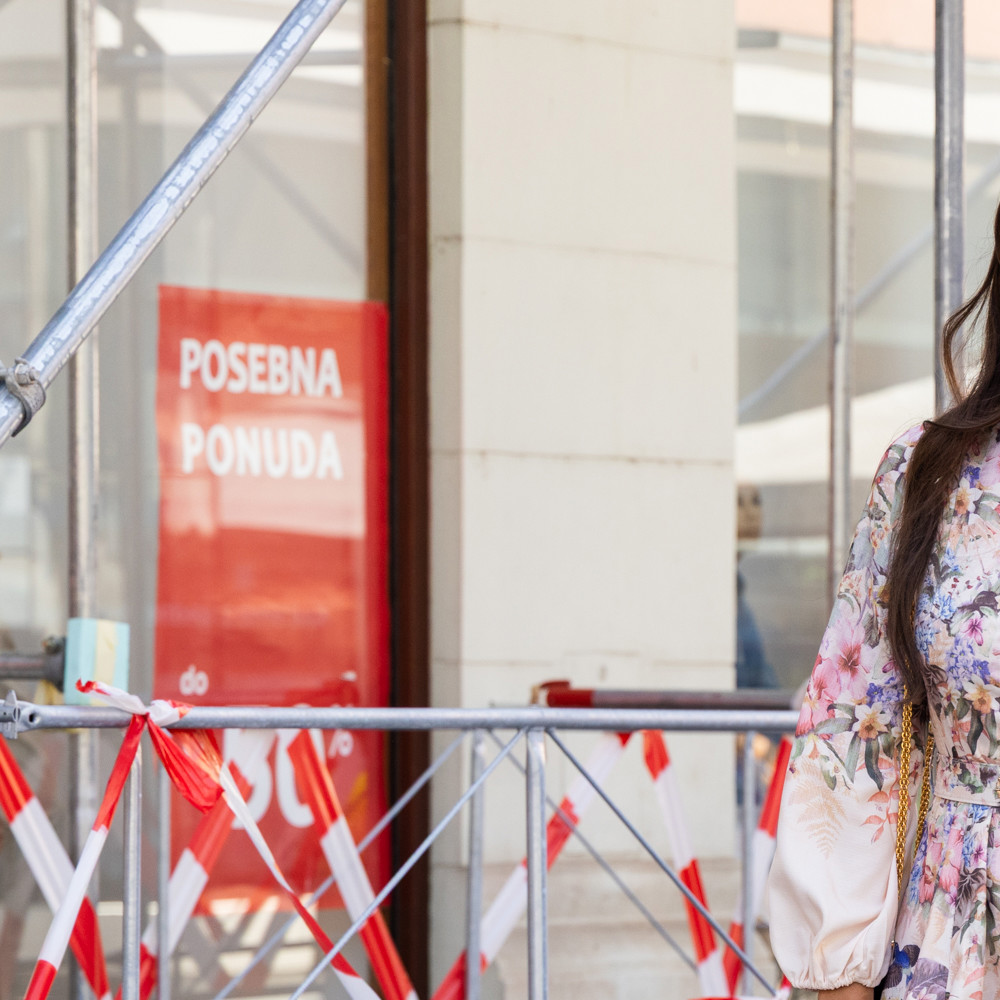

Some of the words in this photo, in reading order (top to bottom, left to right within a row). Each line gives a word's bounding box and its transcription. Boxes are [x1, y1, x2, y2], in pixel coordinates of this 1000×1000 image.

[179, 337, 343, 398] POSEBNA
[181, 422, 343, 481] PONUDA
[179, 664, 209, 696] do
